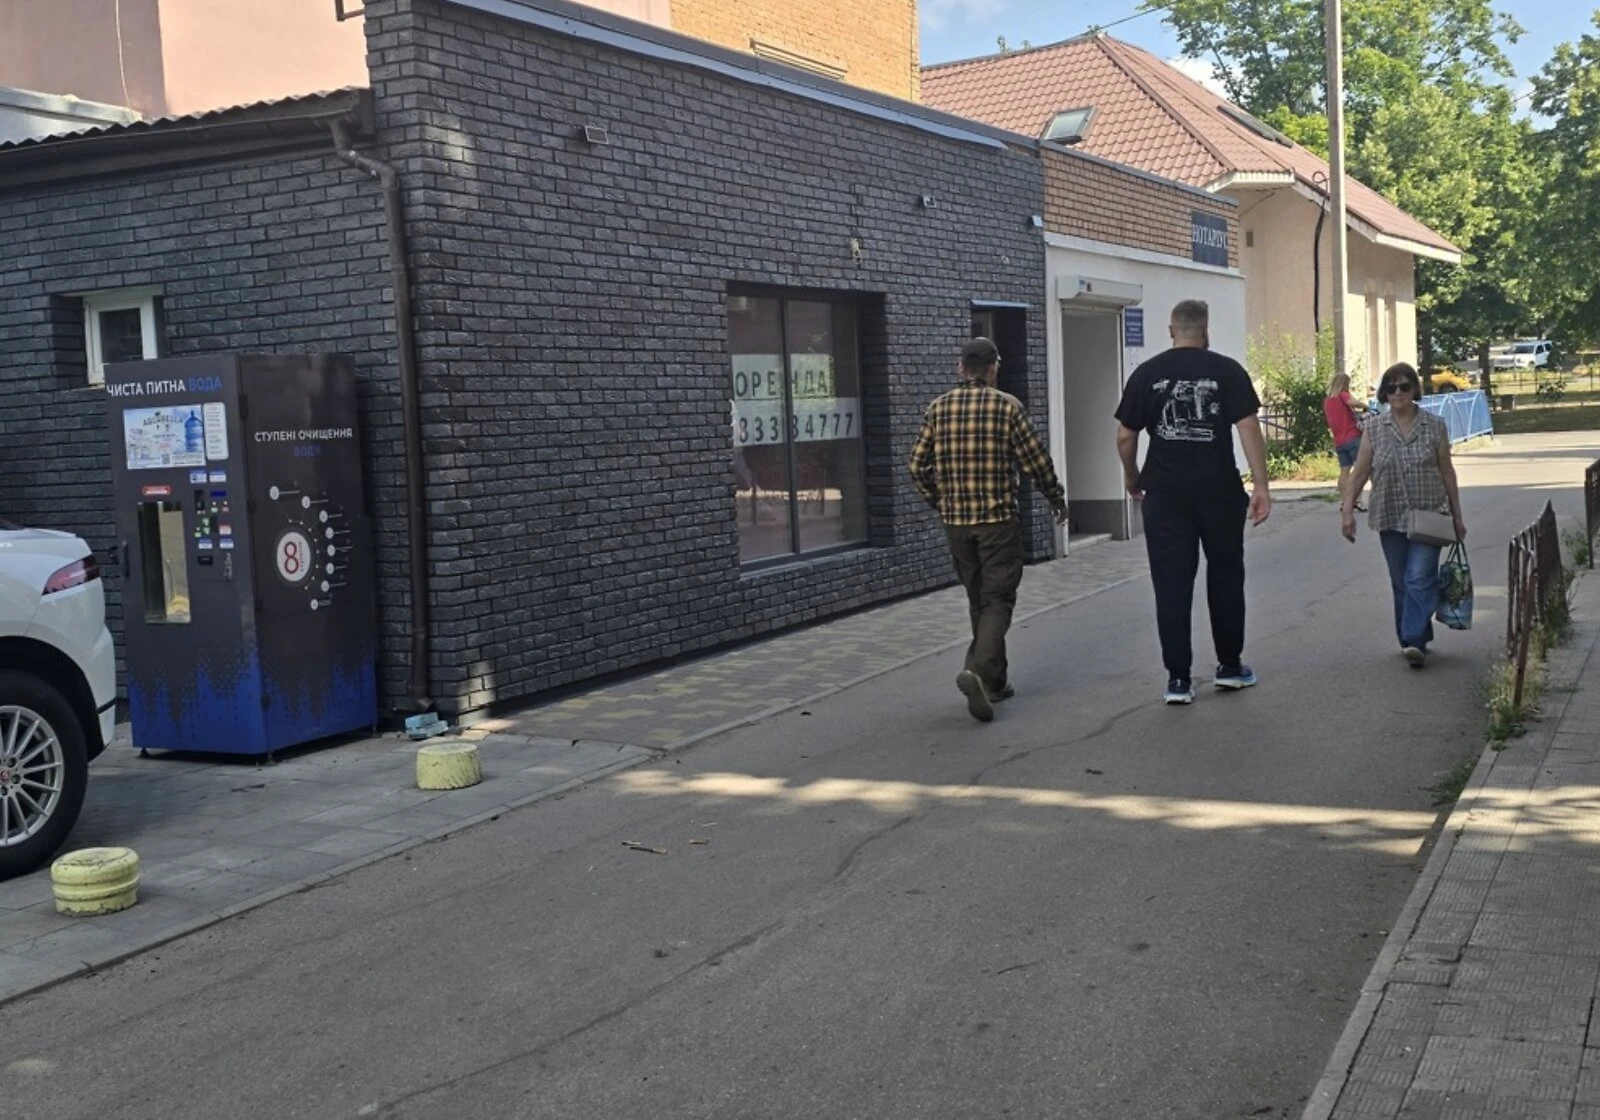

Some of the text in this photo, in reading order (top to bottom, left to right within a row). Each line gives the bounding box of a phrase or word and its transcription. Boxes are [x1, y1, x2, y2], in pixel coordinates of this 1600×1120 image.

[106, 377, 222, 396] ЧИСТА ПИТНА ВОДА
[255, 428, 353, 442] СТУПЕНІ ОЧИЩЕННЯ
[284, 541, 299, 574] 8
